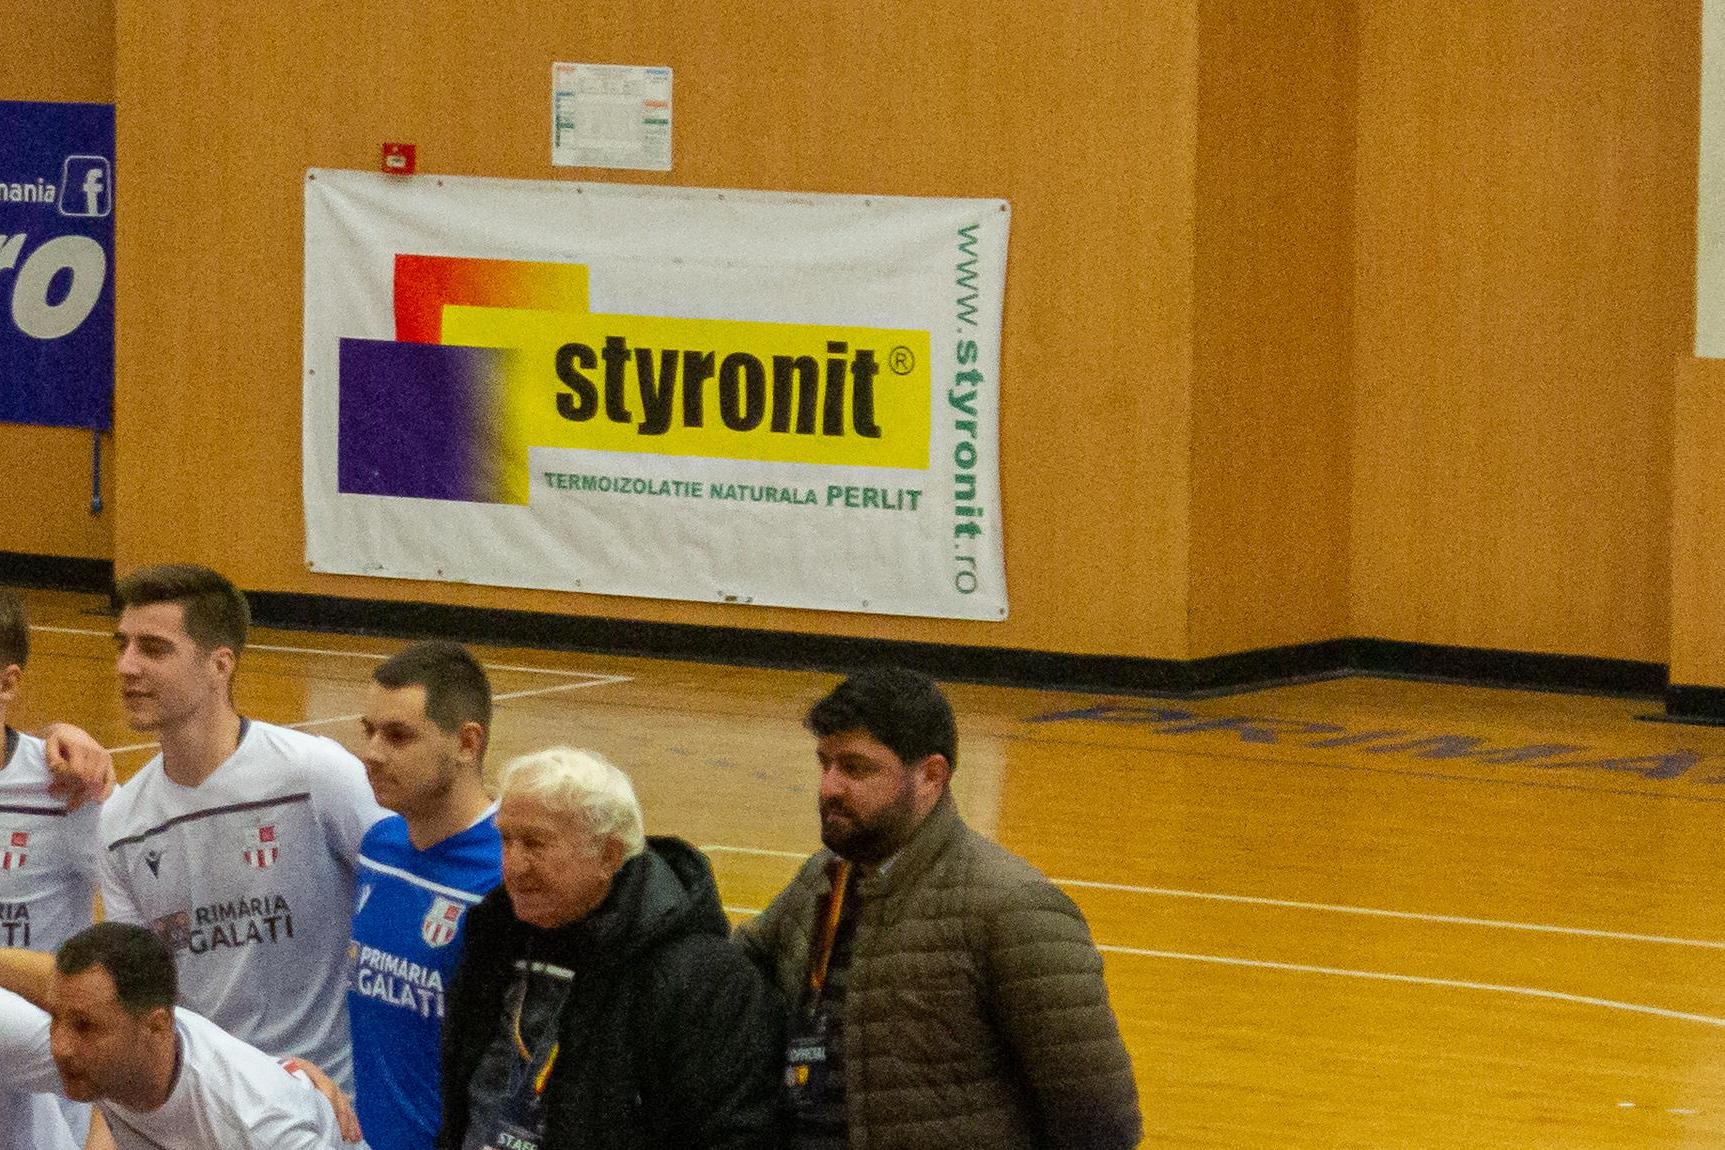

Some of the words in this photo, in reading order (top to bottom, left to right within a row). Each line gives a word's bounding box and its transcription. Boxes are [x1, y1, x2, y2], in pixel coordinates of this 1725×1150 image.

[948, 223, 984, 595] www.styronit.ro
[544, 471, 703, 499] TERMOIZOLATIE
[710, 482, 818, 506] NATURALA
[826, 485, 923, 511] PERLIT
[1025, 704, 1725, 784] PRIMA
[196, 895, 290, 924] RIMARIA
[189, 914, 294, 955] GALATI
[360, 946, 443, 991] PRIMARIA
[358, 968, 445, 1018] GALATI
